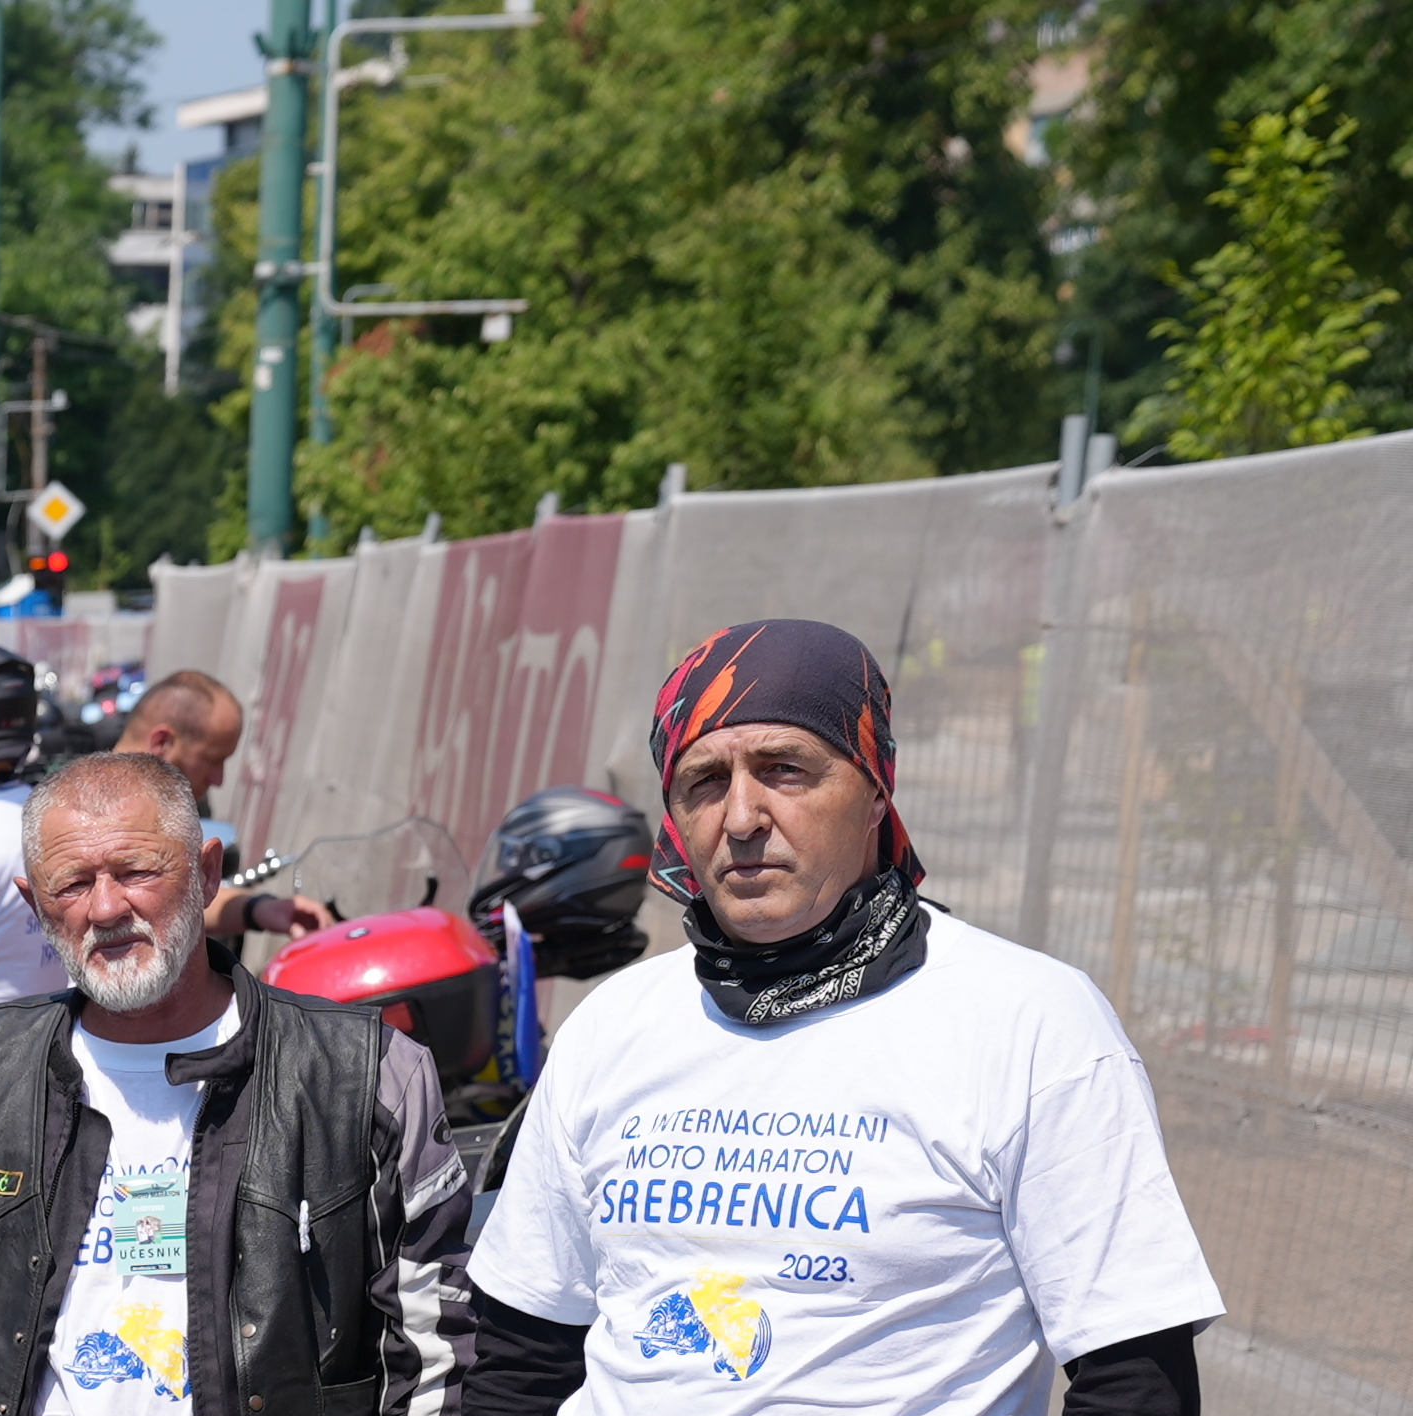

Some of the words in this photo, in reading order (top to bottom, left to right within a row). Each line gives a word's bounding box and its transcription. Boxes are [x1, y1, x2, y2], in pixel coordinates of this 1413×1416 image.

[649, 1108, 888, 1143] INTERNACIONALNI
[625, 1144, 705, 1170] MOTO
[714, 1147, 853, 1176] MARATON
[599, 1179, 870, 1234] SREBRENICA
[119, 1246, 181, 1260] UČESNIK
[777, 1254, 855, 1283] 2023.
